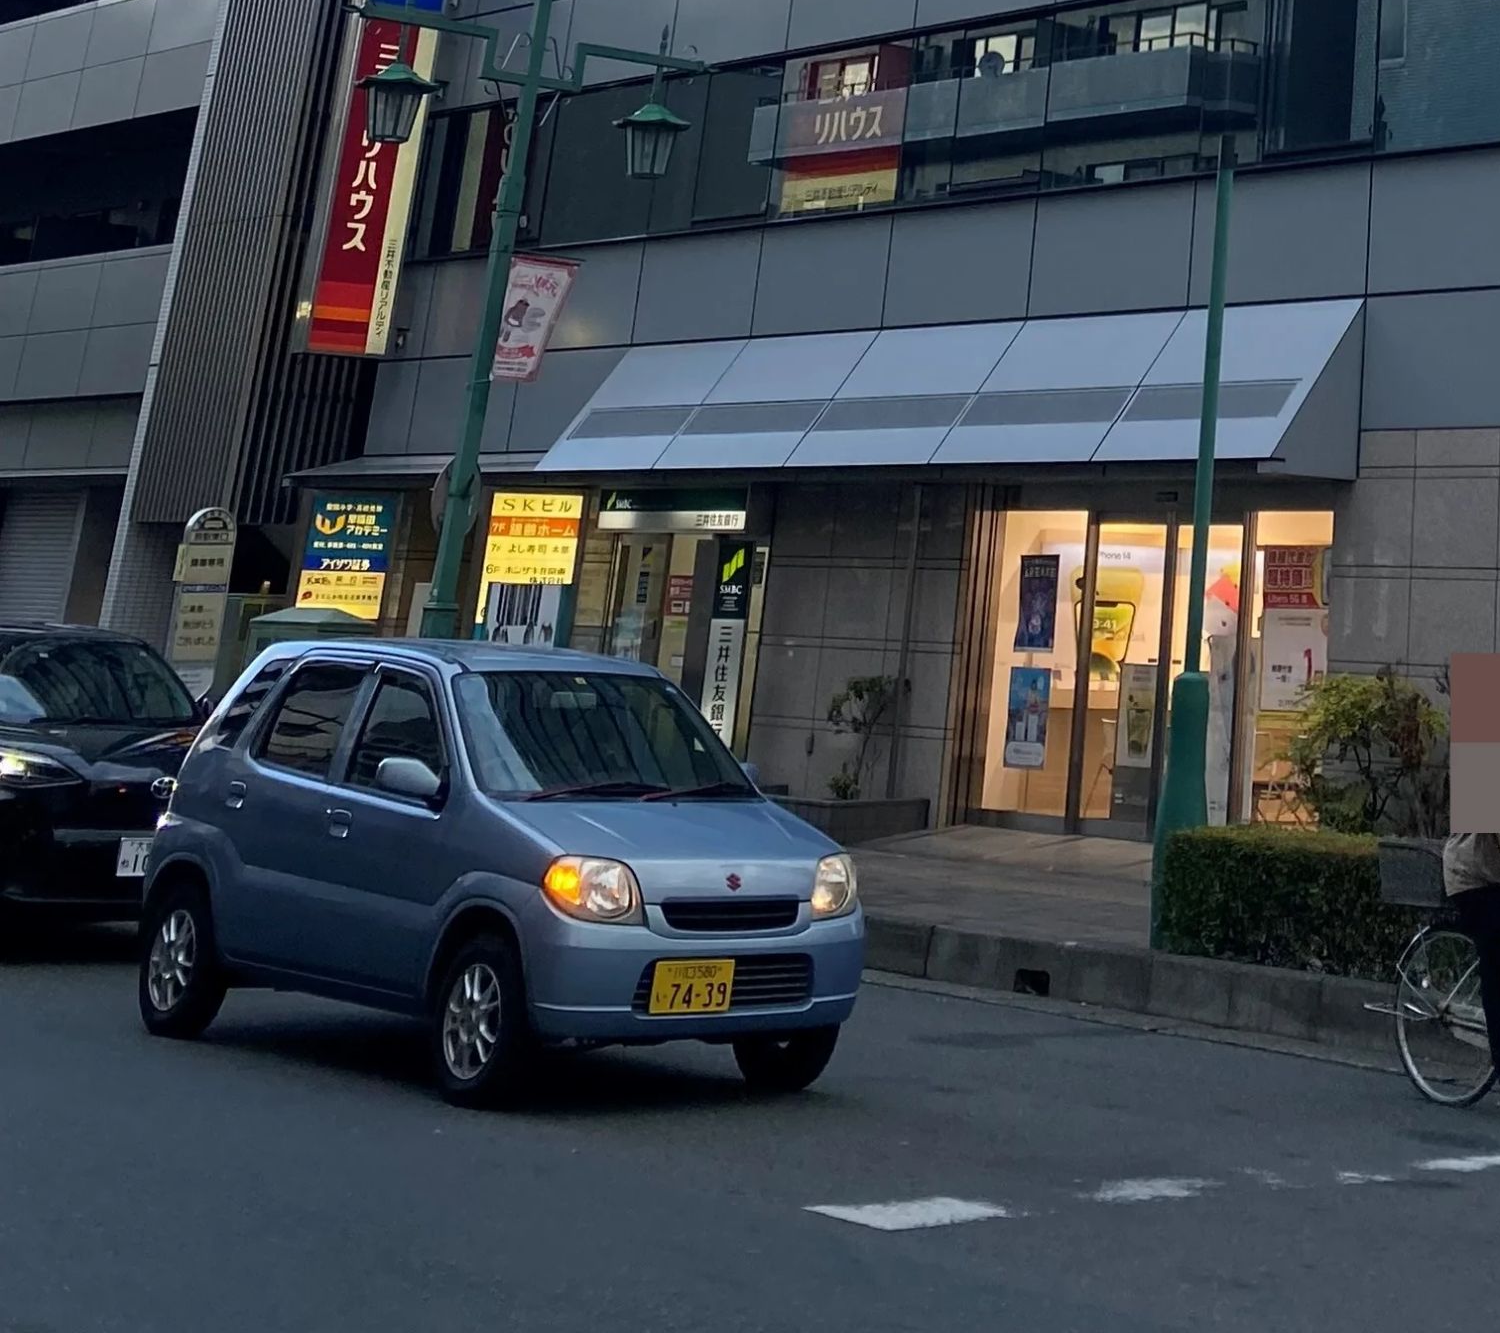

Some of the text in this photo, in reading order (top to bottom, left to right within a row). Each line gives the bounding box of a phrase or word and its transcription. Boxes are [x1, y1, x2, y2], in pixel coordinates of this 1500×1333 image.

[814, 105, 883, 145] リハウス
[341, 42, 400, 252] 三リハウス
[695, 514, 738, 527] 三井住友銀行
[719, 584, 743, 595] SMBC
[669, 982, 727, 1010] 74-39
